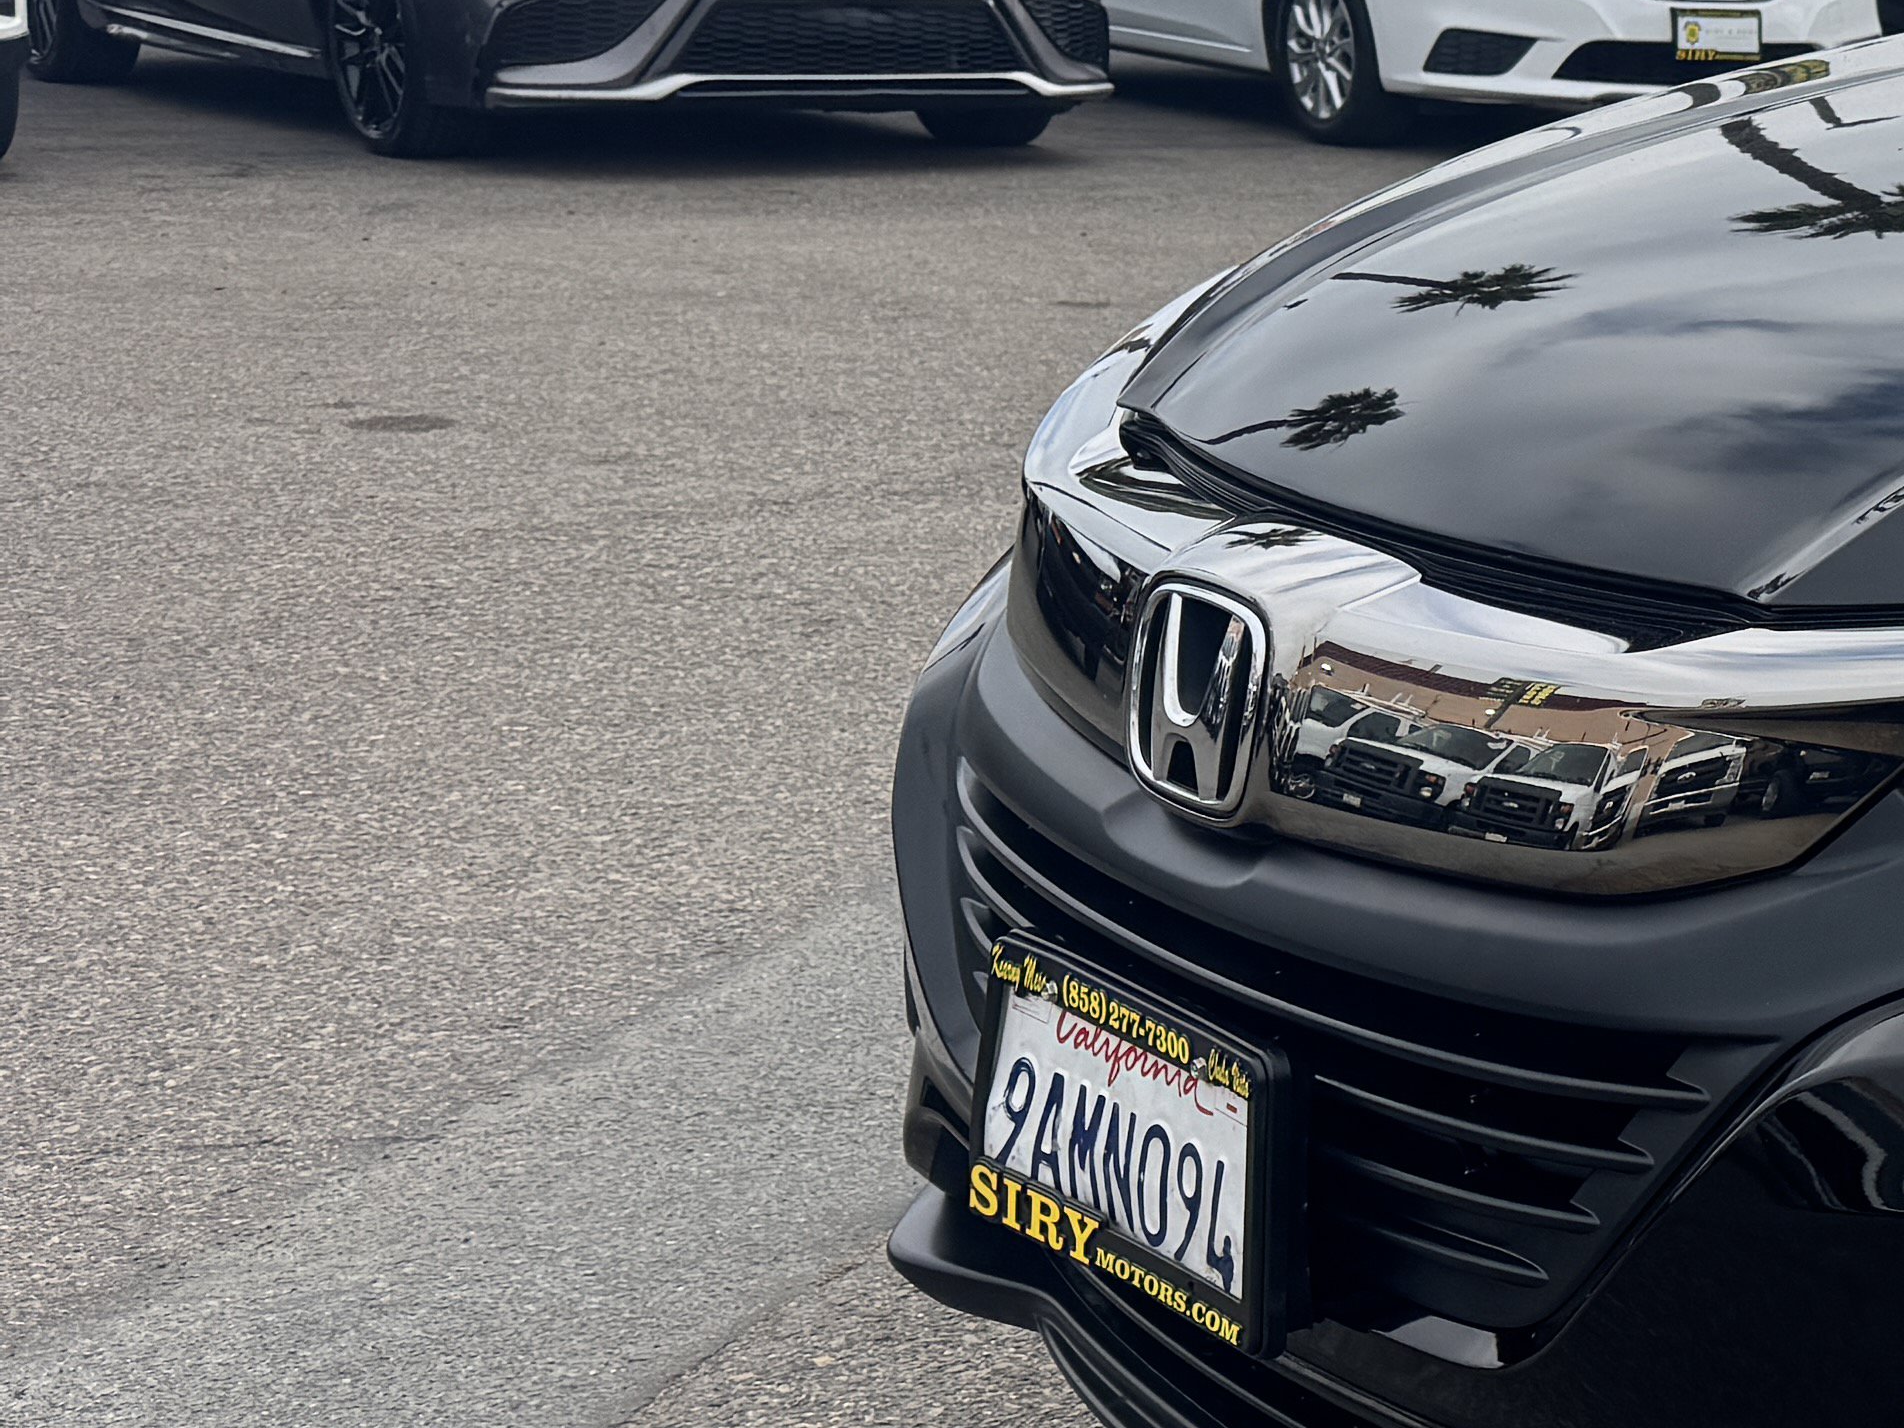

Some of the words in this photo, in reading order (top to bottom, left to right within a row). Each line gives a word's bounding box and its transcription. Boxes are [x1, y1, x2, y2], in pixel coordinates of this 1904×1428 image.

[1056, 1010, 1214, 1117] California
[1062, 974, 1107, 1024] (858)
[1108, 999, 1190, 1065] 277-7300
[996, 1056, 1234, 1292] 9AMN094
[969, 1163, 1100, 1266] SIRY
[1095, 1246, 1243, 1347] MOTORS.COM
